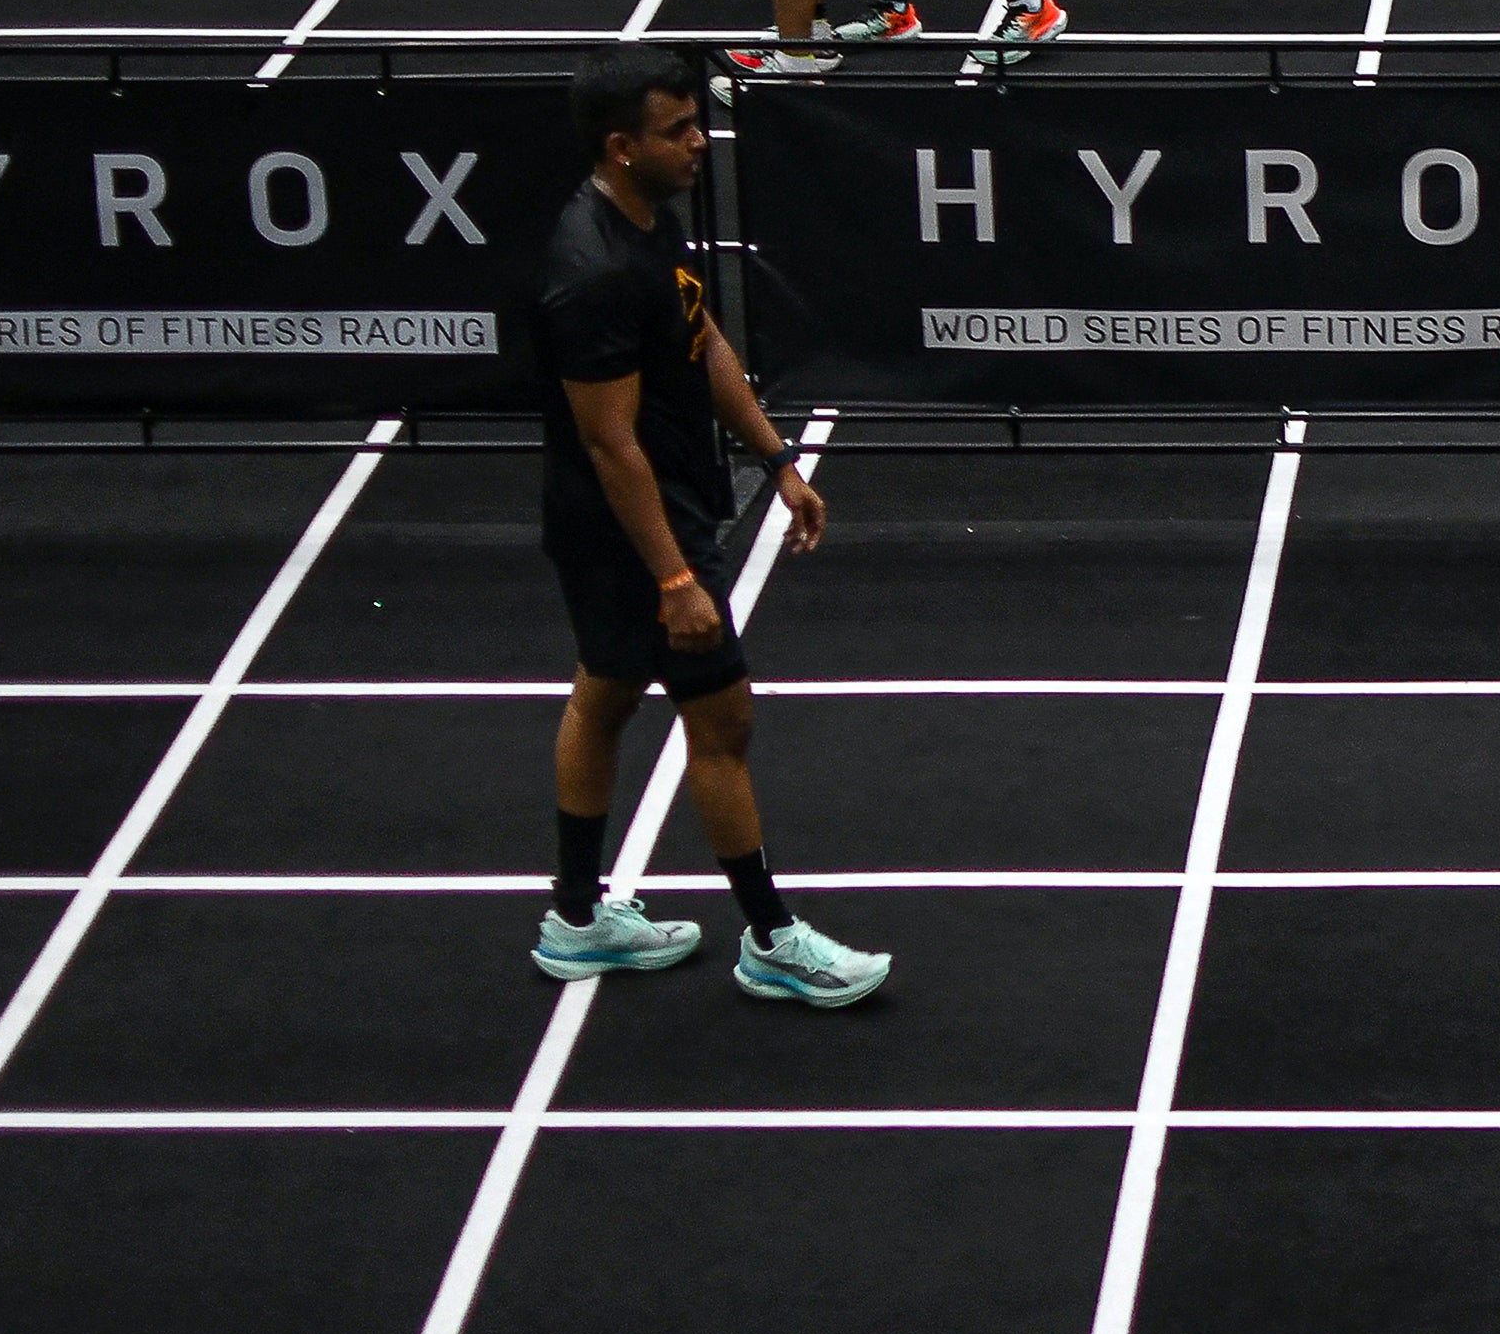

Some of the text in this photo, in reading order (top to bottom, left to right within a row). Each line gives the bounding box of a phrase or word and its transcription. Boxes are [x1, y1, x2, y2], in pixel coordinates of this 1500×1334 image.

[98, 317, 145, 348] OF
[160, 317, 323, 348] FITNESS
[339, 317, 486, 348] RACING
[931, 315, 1068, 344] WORLD
[1083, 315, 1221, 345] SERIES
[1237, 315, 1286, 345] OF
[1302, 314, 1466, 345] FITNESS
